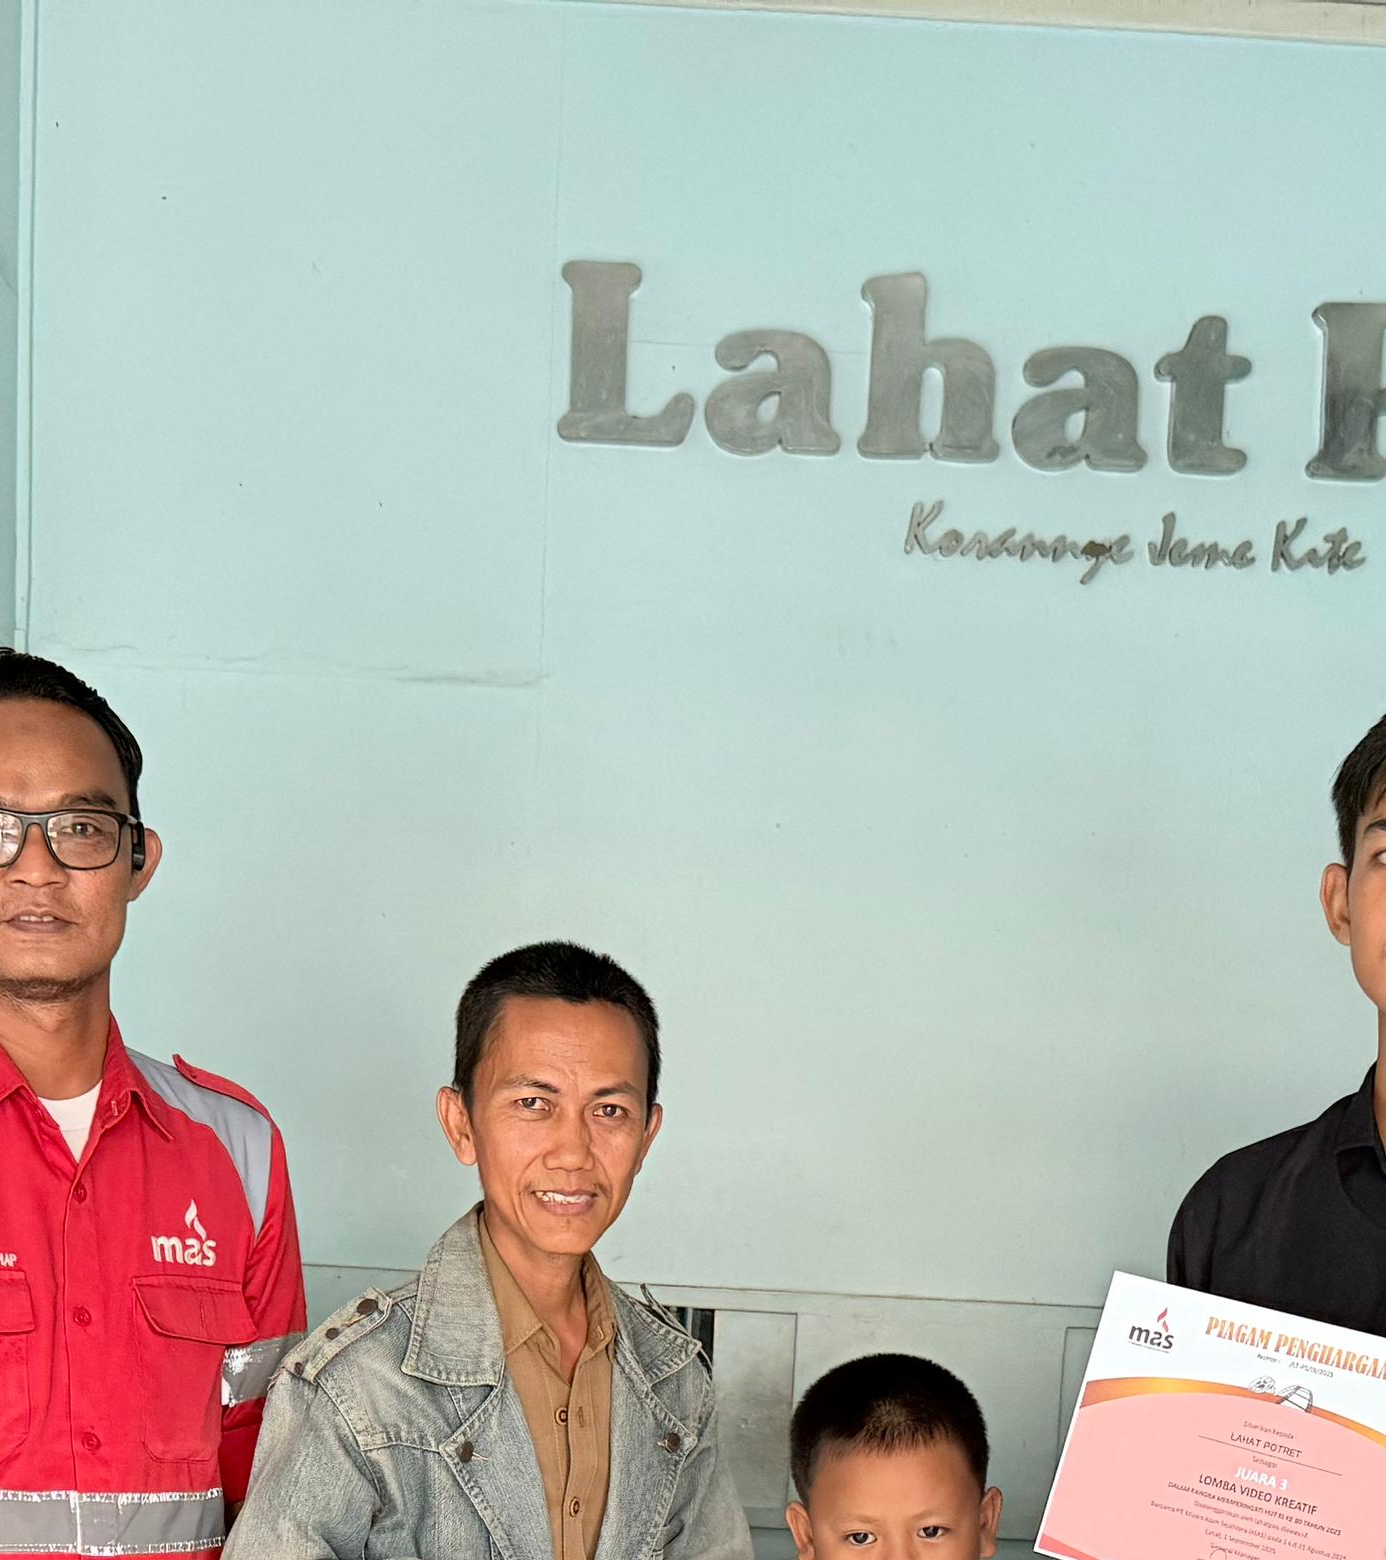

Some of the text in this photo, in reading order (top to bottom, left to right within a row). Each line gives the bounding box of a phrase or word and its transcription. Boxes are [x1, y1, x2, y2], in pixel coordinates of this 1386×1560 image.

[557, 260, 1251, 476] Lahat
[1148, 512, 1257, 569] Jeme
[1271, 517, 1366, 574] Kite
[151, 1235, 217, 1267] mas
[1127, 1324, 1175, 1350] mas
[1203, 1315, 1273, 1350] PIAGAM
[1229, 1431, 1303, 1459] LAHAT POTRET
[1197, 1473, 1318, 1516] LOMBA VIDEO KREATIF
[1233, 1465, 1290, 1491] JUARA 3
